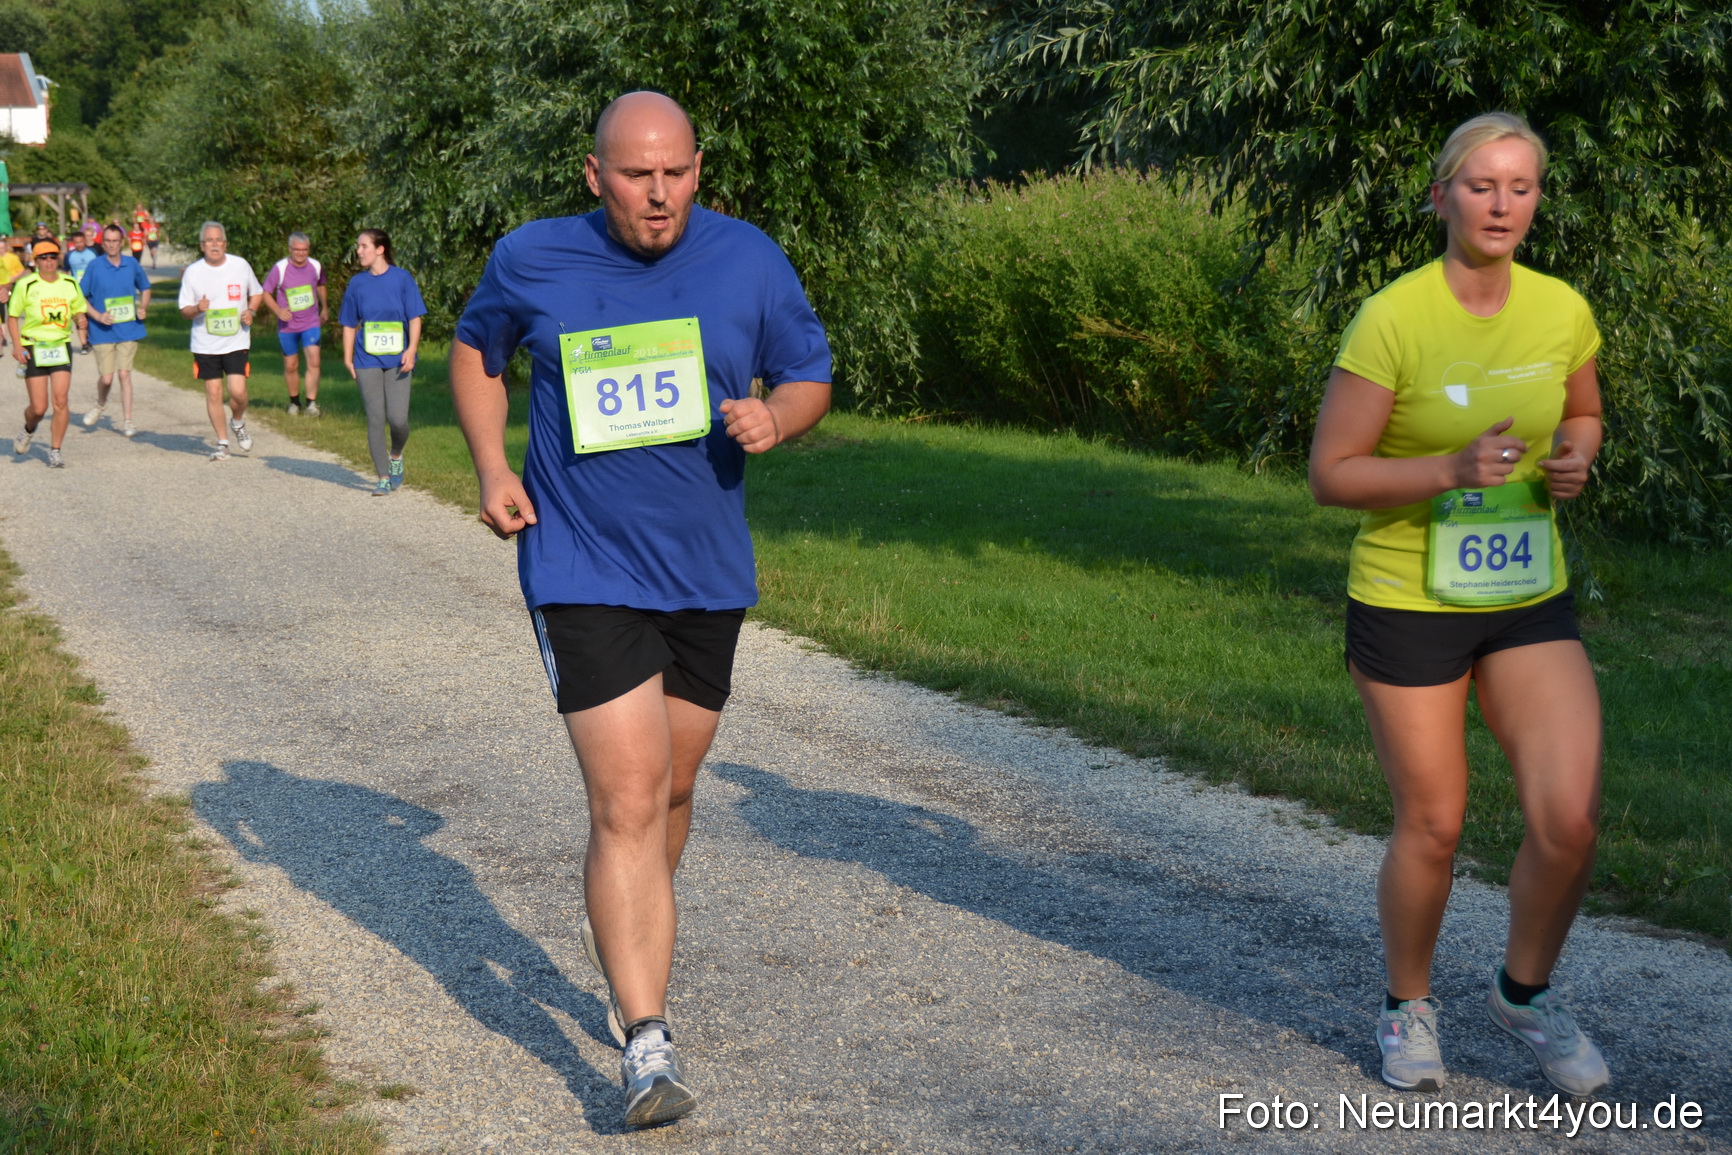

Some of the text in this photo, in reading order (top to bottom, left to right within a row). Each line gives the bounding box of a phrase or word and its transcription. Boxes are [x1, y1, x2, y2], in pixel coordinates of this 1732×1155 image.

[293, 295, 310, 306] 290
[49, 312, 61, 322] M
[112, 307, 129, 317] 733
[213, 319, 233, 329] 211
[373, 335, 395, 346] 791
[41, 349, 61, 360] 342
[584, 345, 631, 360] firmenlauf
[633, 347, 658, 358] 2015
[596, 370, 680, 416] 815
[608, 417, 675, 432] Thomas Walbert
[1452, 504, 1499, 514] firmenlauf
[1458, 531, 1532, 573] 684
[1449, 578, 1537, 589] Stephanie Heiderscheid
